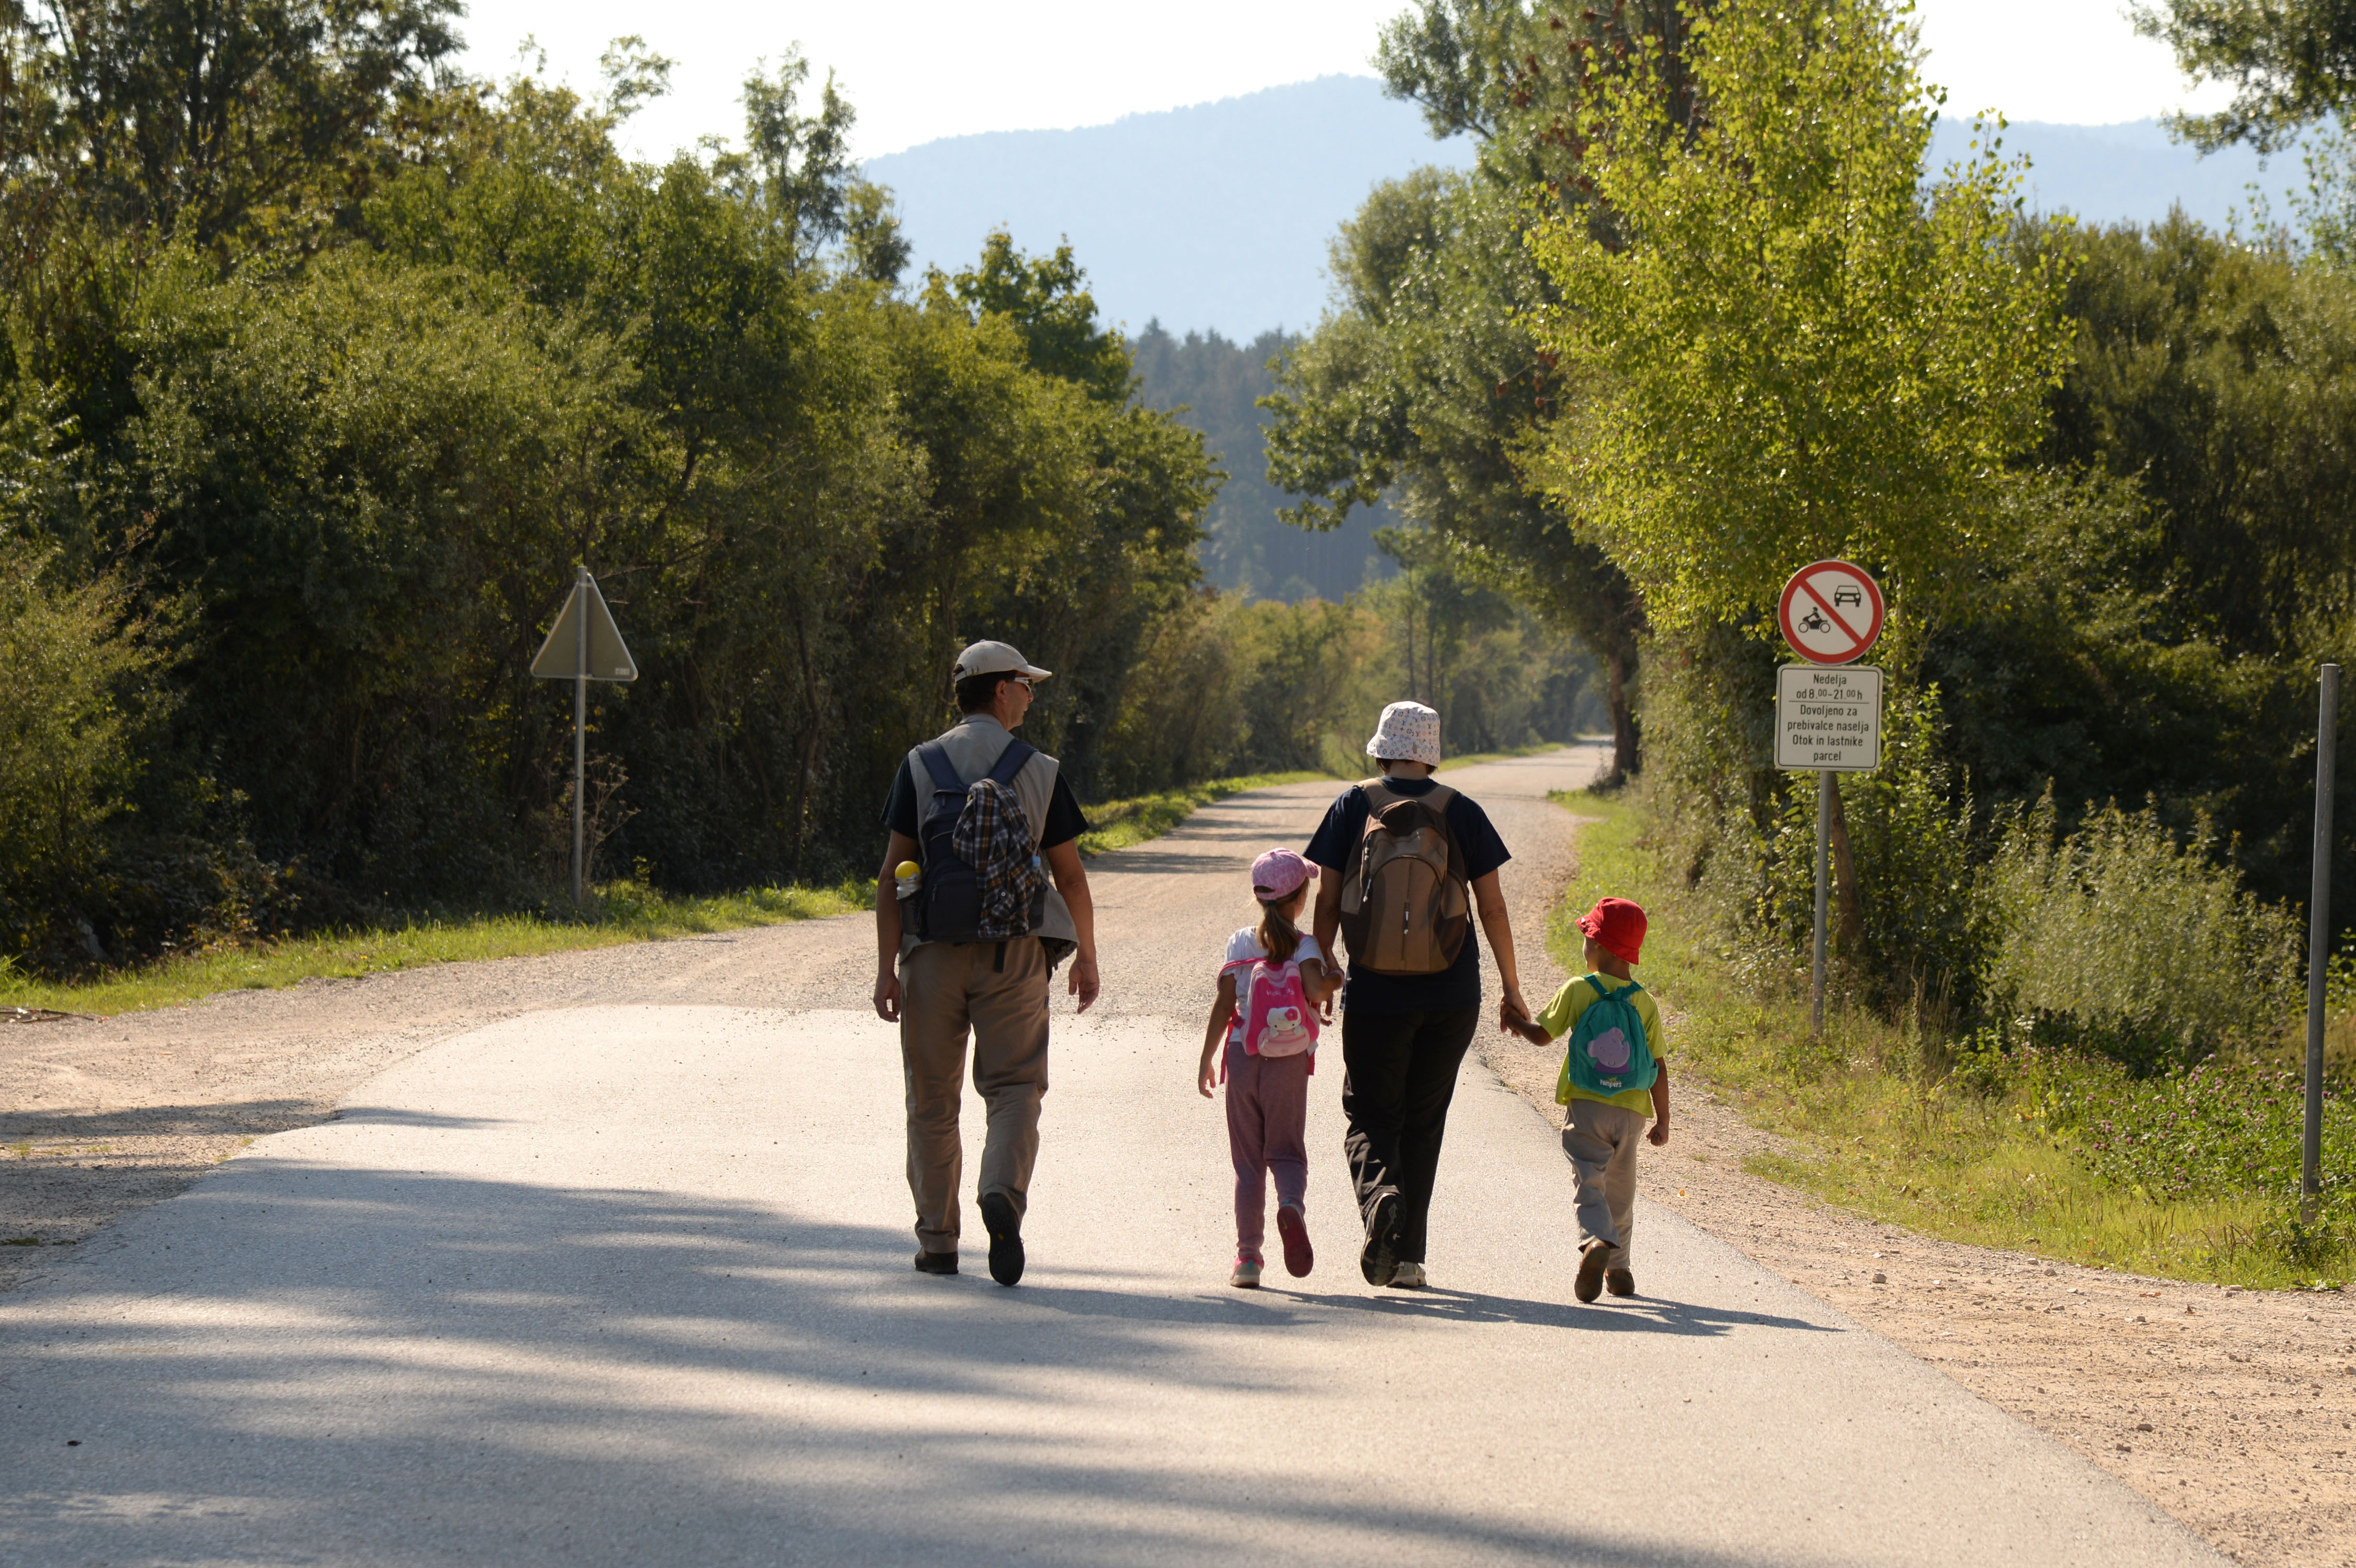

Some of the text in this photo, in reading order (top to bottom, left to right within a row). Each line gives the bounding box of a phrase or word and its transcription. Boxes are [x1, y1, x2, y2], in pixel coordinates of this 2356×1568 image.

[1813, 674, 1847, 687] Nedelja
[1796, 689, 1806, 699] od
[1800, 705, 1843, 718] Dovoljeno
[1787, 720, 1869, 733] prebivalce naselja
[1793, 735, 1863, 747] Otok in lastnike
[1813, 751, 1841, 763] parcel
[1600, 1079, 1622, 1088] Pampers
